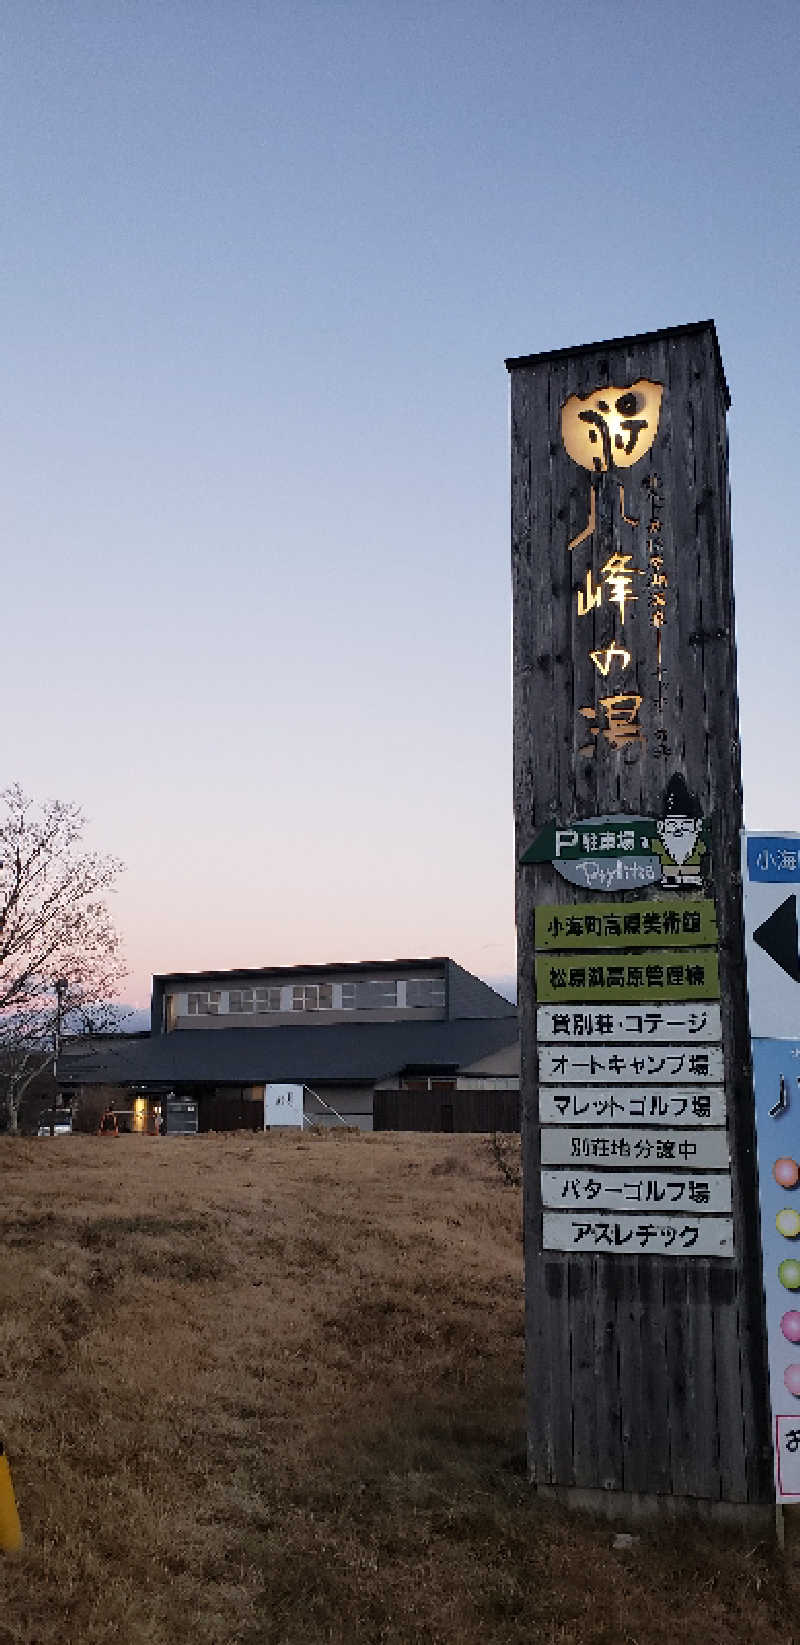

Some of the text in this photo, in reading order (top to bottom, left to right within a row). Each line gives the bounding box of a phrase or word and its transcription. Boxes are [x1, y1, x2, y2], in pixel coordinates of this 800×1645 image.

[756, 848, 800, 873] 小海
[548, 910, 701, 938] 小海町高原美術館
[549, 965, 705, 990] 松原湖高原管理棟
[551, 1054, 709, 1076] オートキャンプ場
[553, 1095, 711, 1118] マレットゴルフ場
[570, 1137, 697, 1160] 別荘地分譲中
[561, 1178, 710, 1203] パターゴルフ場
[571, 1221, 699, 1247] アスレチック
